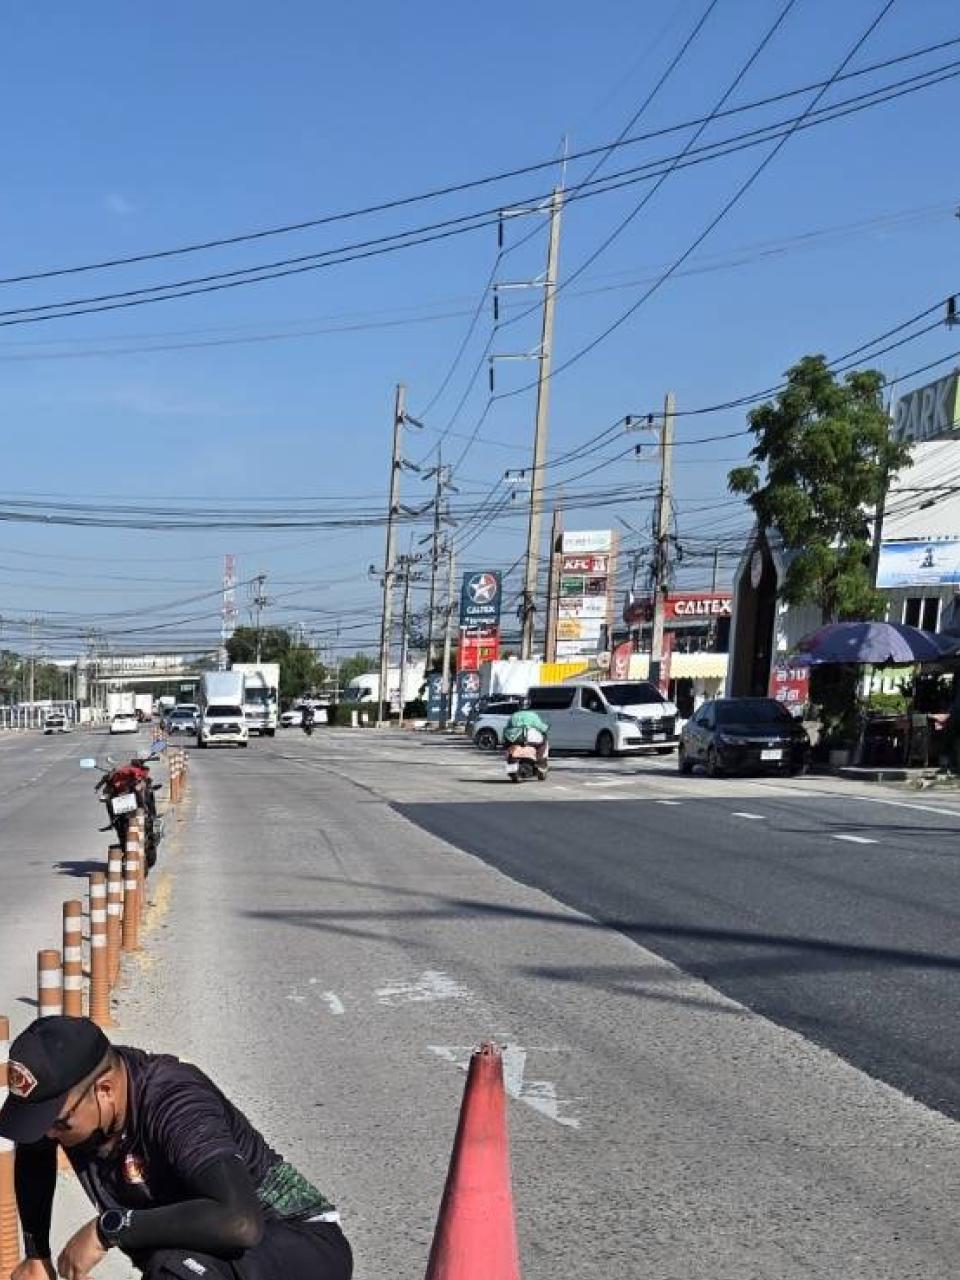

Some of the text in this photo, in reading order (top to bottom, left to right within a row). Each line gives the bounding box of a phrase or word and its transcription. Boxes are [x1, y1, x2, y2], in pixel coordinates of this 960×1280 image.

[563, 559, 589, 569] KFC
[466, 606, 496, 614] CALTEX
[674, 599, 732, 615] CALTEX
